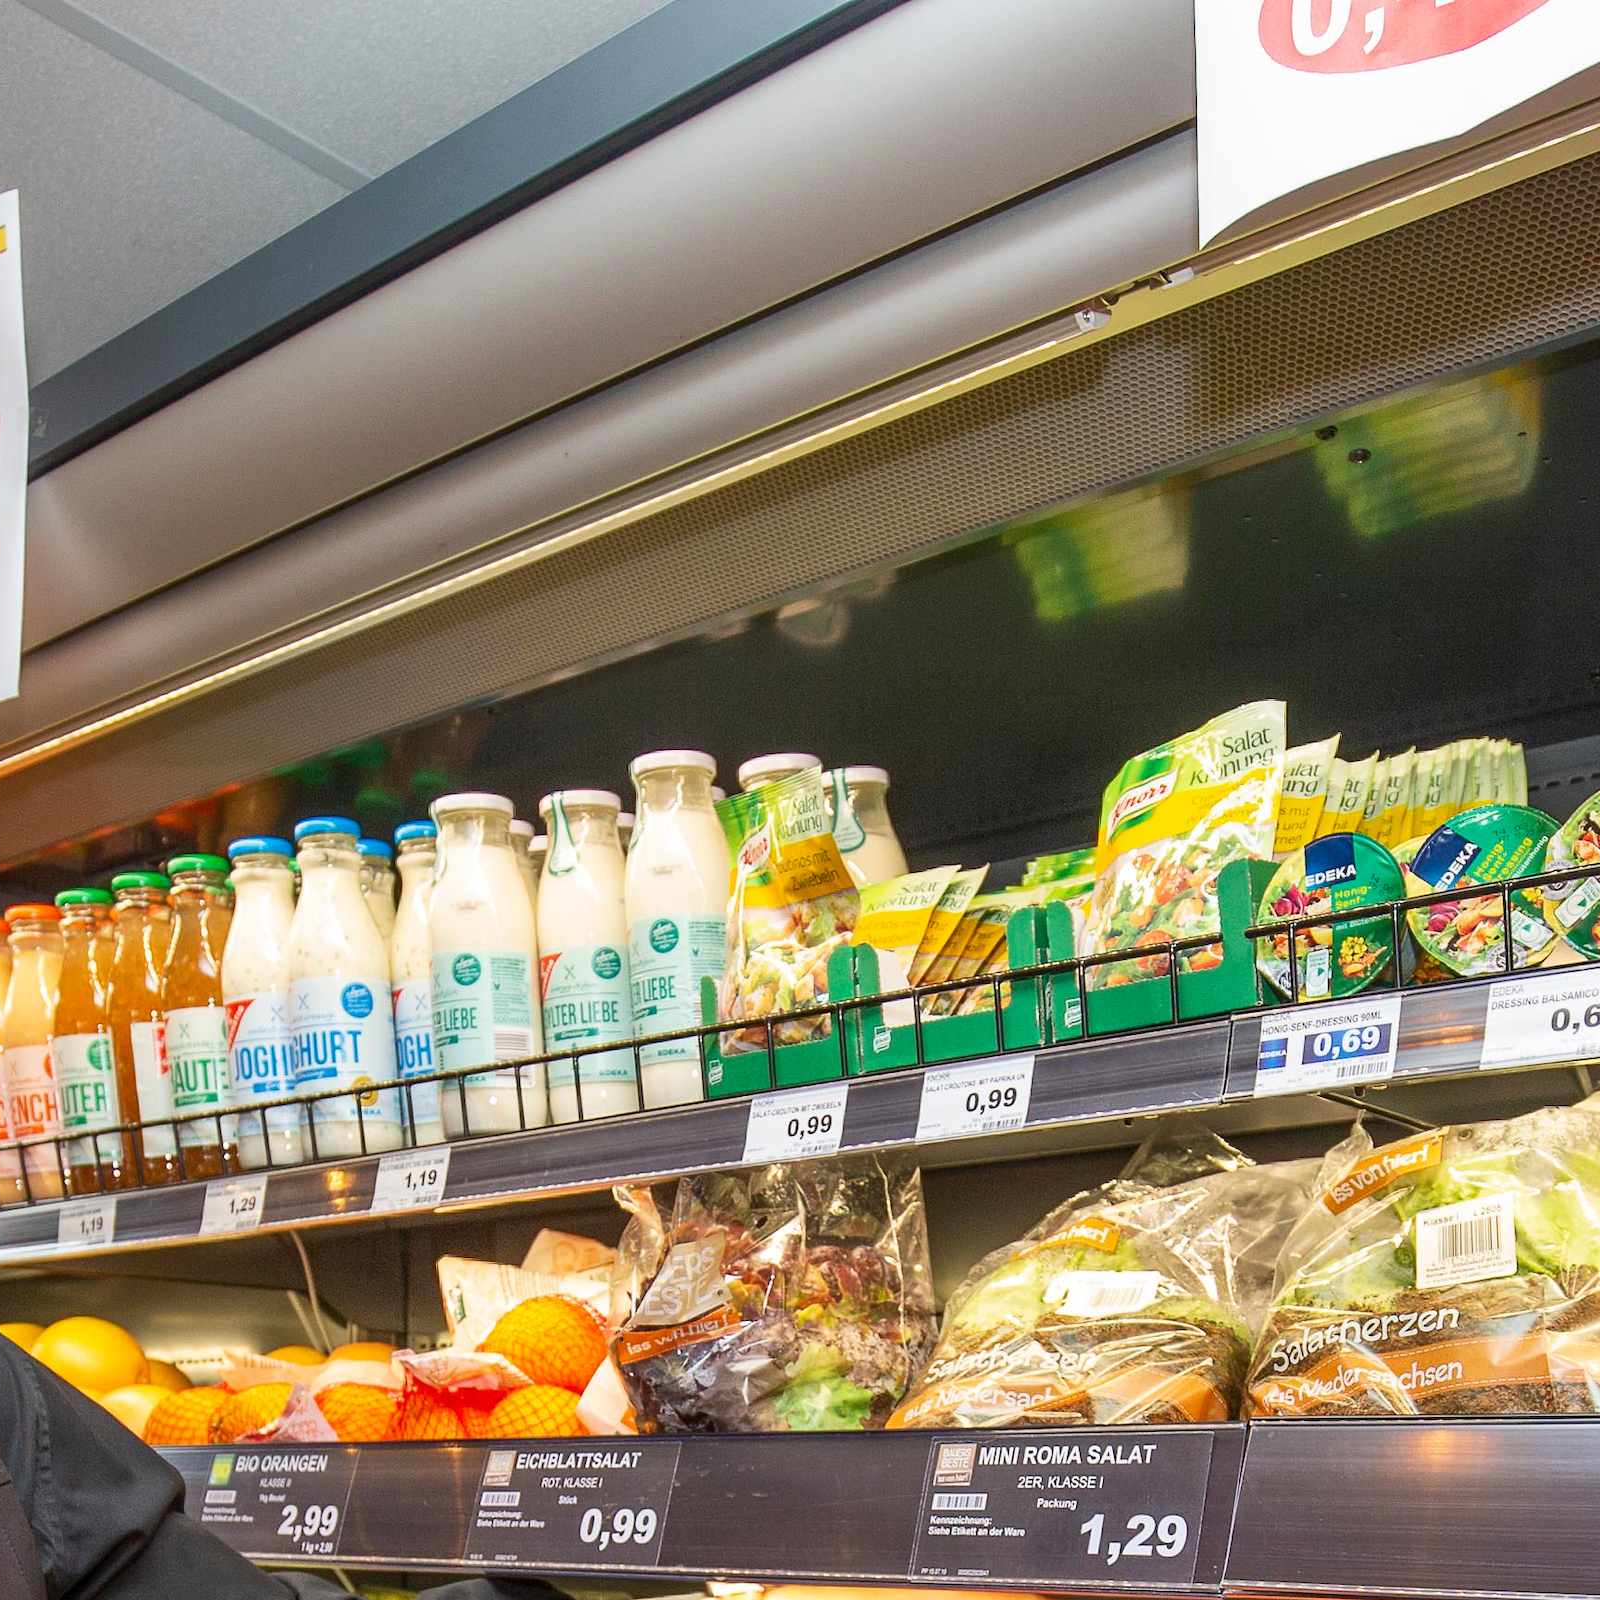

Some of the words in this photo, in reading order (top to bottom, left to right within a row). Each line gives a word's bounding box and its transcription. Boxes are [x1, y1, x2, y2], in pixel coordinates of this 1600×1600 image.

[1222, 727, 1271, 758] Salat
[1305, 864, 1356, 886] EDEKA
[640, 974, 676, 1001] LIEBE
[1490, 996, 1540, 1011] DRESSING
[1541, 988, 1599, 1005] BALSAMICO
[443, 1006, 478, 1032] LIEBE
[580, 999, 619, 1025] LIEBE
[1261, 1014, 1359, 1037] HONIG-SENF-DRESSING
[1312, 1025, 1382, 1060] 0,69
[965, 1087, 1018, 1116] 0,99
[786, 1114, 834, 1140] 0,99
[403, 1168, 438, 1191] 1,19
[228, 1195, 257, 1216] 1,29
[1270, 1307, 1460, 1373] Salatherzen
[235, 1454, 259, 1472] BIO
[260, 1454, 329, 1472] ORANGEN
[515, 1451, 643, 1471] EICHBLATTSALAT
[941, 1457, 970, 1469] BESTE
[978, 1446, 1020, 1466] MINI
[1023, 1445, 1083, 1465] ROMA
[1086, 1445, 1157, 1465] SALAT
[562, 1477, 598, 1489] KLASSE
[1017, 1476, 1045, 1490] 2ER,
[1048, 1476, 1096, 1489] KLASSE
[1036, 1497, 1077, 1511] Packung
[277, 1504, 339, 1541] 2,99
[578, 1507, 658, 1551] 0,99
[1080, 1514, 1188, 1565] 1,29
